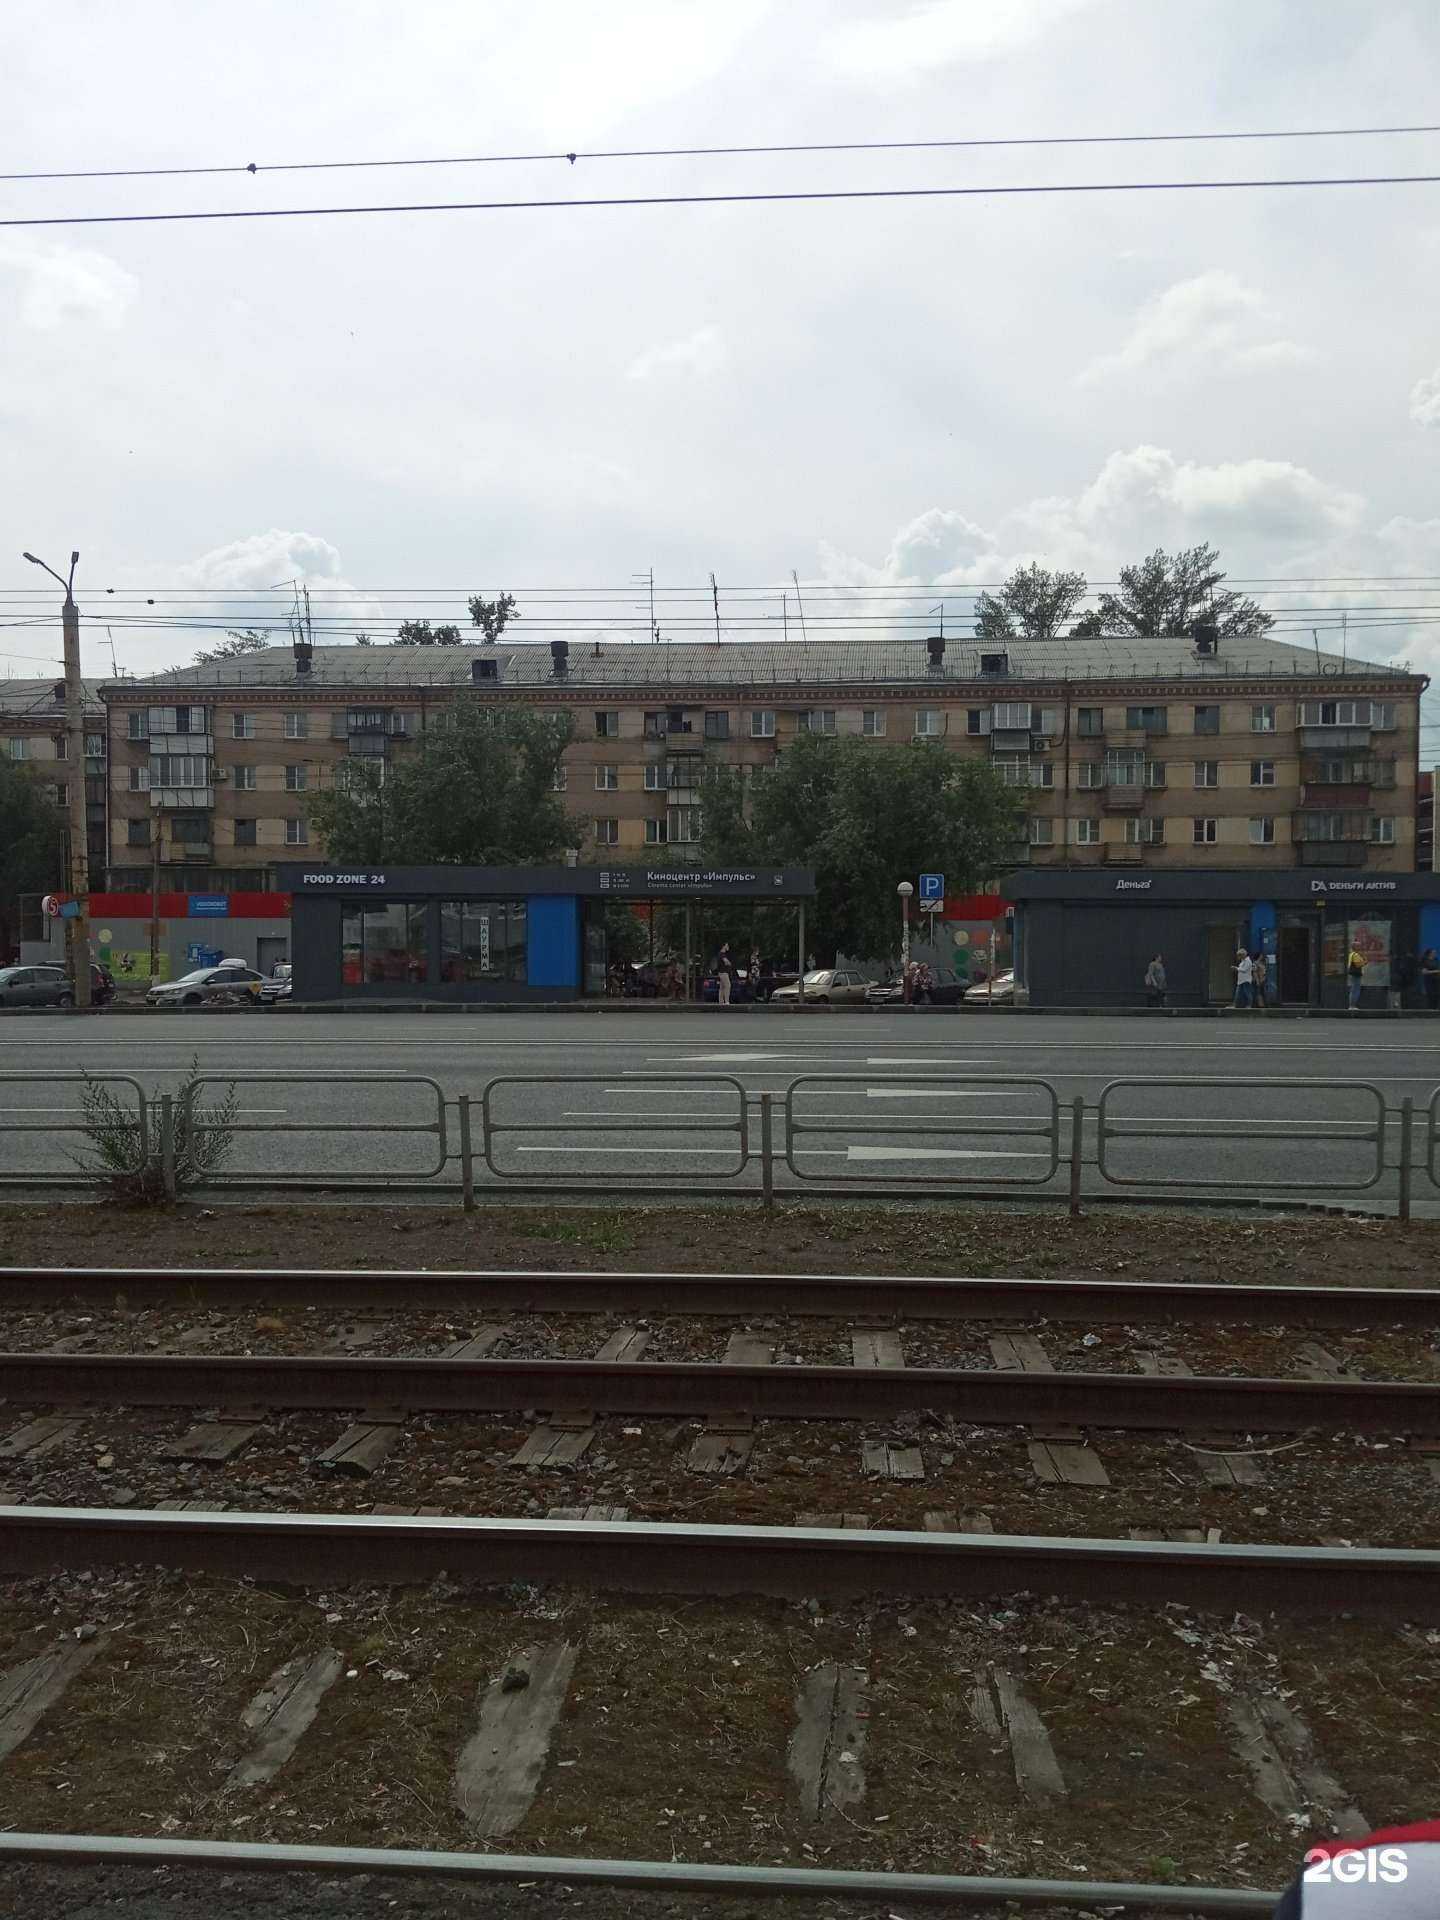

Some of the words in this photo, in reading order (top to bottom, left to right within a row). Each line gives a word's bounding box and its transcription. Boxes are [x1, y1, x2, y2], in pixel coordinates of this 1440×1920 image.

[303, 874, 334, 884] FOOD
[336, 874, 367, 884] ZONE
[371, 875, 386, 884] 24
[647, 871, 700, 882] Киноцентр
[702, 871, 756, 883] «Импульс»
[926, 877, 939, 895] P
[480, 918, 489, 969] ШАУРМА
